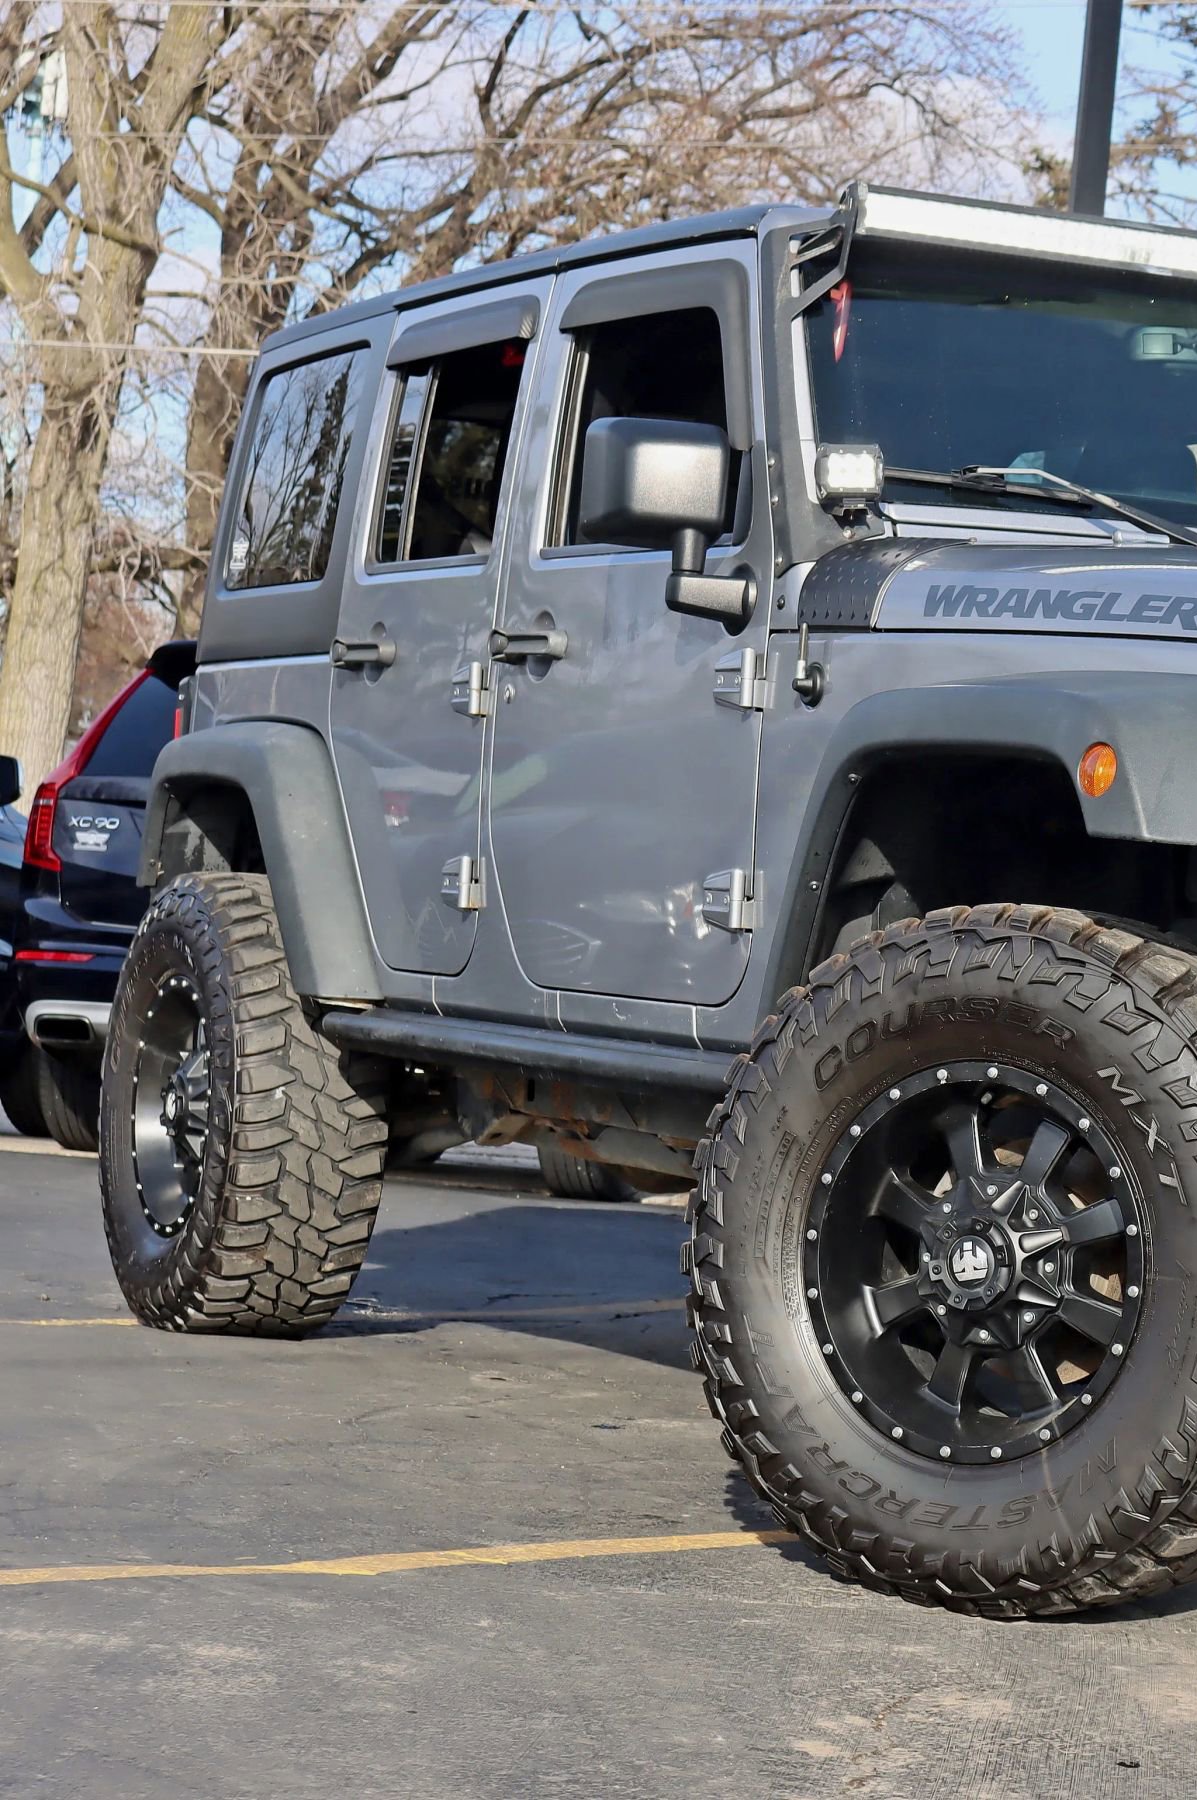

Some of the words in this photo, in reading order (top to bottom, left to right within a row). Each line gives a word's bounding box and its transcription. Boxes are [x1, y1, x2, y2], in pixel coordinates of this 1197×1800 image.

[813, 994, 1077, 1093] COURSER
[1096, 1063, 1189, 1207] MXT
[741, 1312, 1119, 1532] MASTERCRAFT
